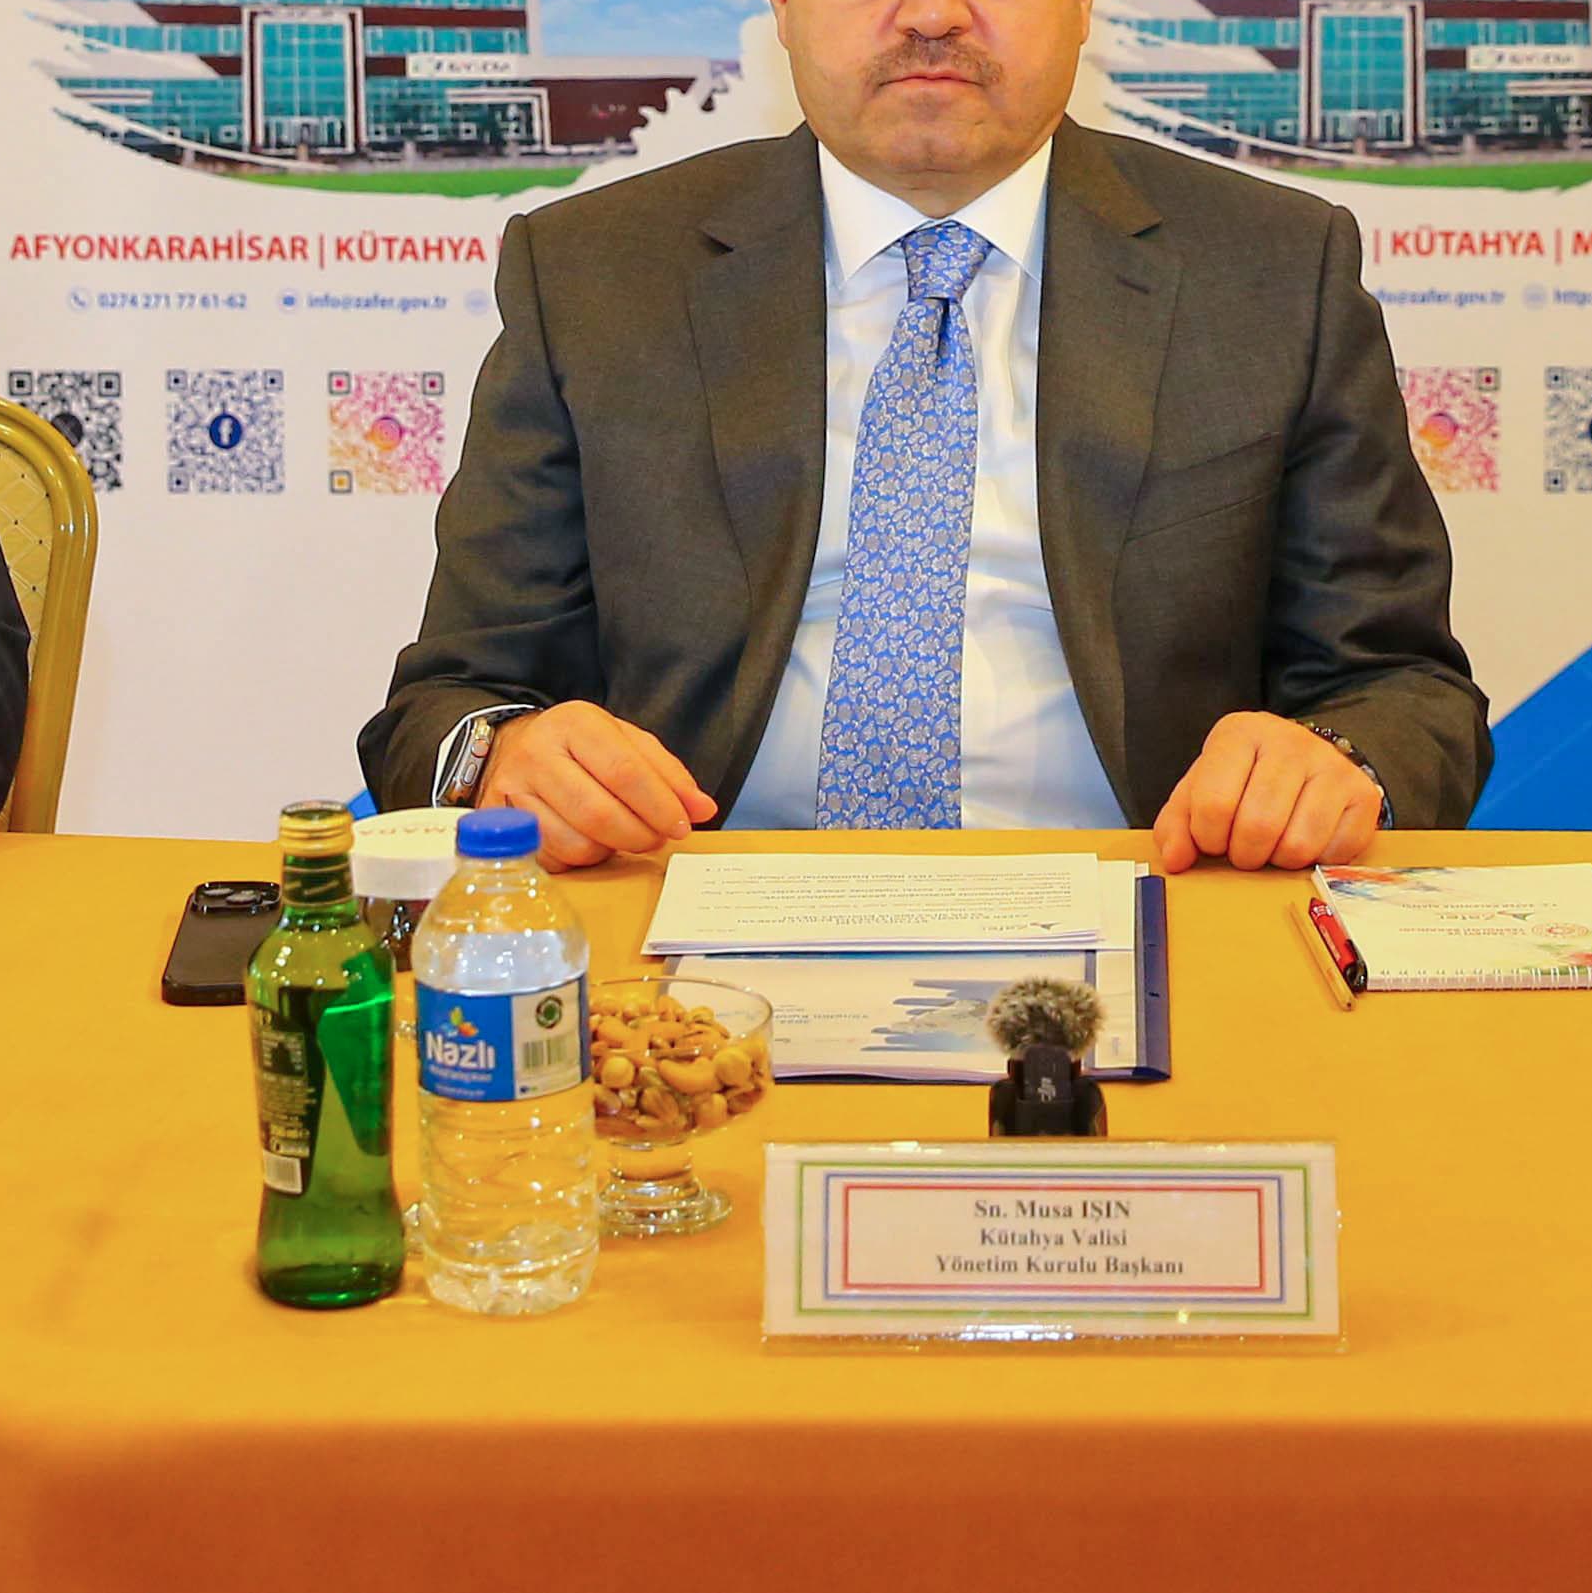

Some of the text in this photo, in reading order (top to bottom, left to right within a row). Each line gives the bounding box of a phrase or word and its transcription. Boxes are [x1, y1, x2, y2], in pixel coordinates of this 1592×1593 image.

[9, 229, 488, 263] AFYONKARAHİSAR KÜTAHYA
[1391, 225, 1545, 256] KÜTAHYA
[425, 1031, 496, 1069] Nazlı
[974, 1199, 1132, 1223] Sn. Musa IŞIN
[980, 1228, 1128, 1251] Kütahya Valisi
[935, 1255, 1184, 1281] Yönetim Kurulu Başkanı
